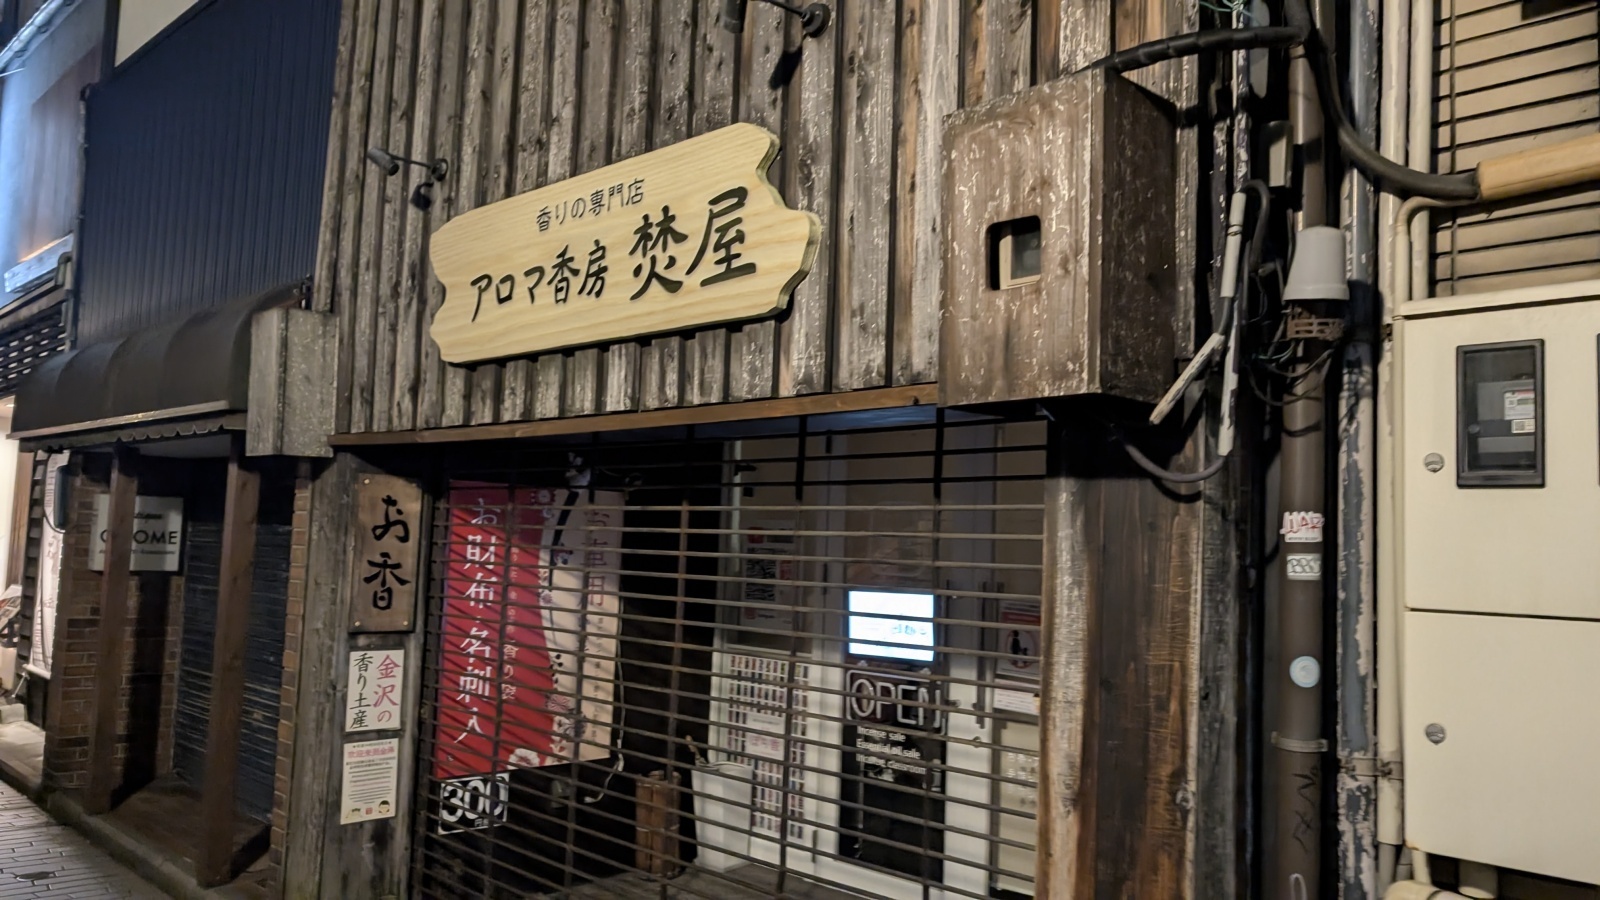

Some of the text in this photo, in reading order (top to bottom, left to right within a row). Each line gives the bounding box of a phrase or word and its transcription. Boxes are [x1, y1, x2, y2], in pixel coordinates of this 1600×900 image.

[536, 178, 645, 232] 香りの専門店
[470, 186, 757, 323] アロマ香房 焚屋
[363, 494, 411, 610] お香
[350, 652, 374, 729] 香り土産
[373, 654, 401, 723] 金沢の
[851, 679, 941, 728] OPEN
[888, 732, 906, 742] sale
[902, 748, 921, 760] sale
